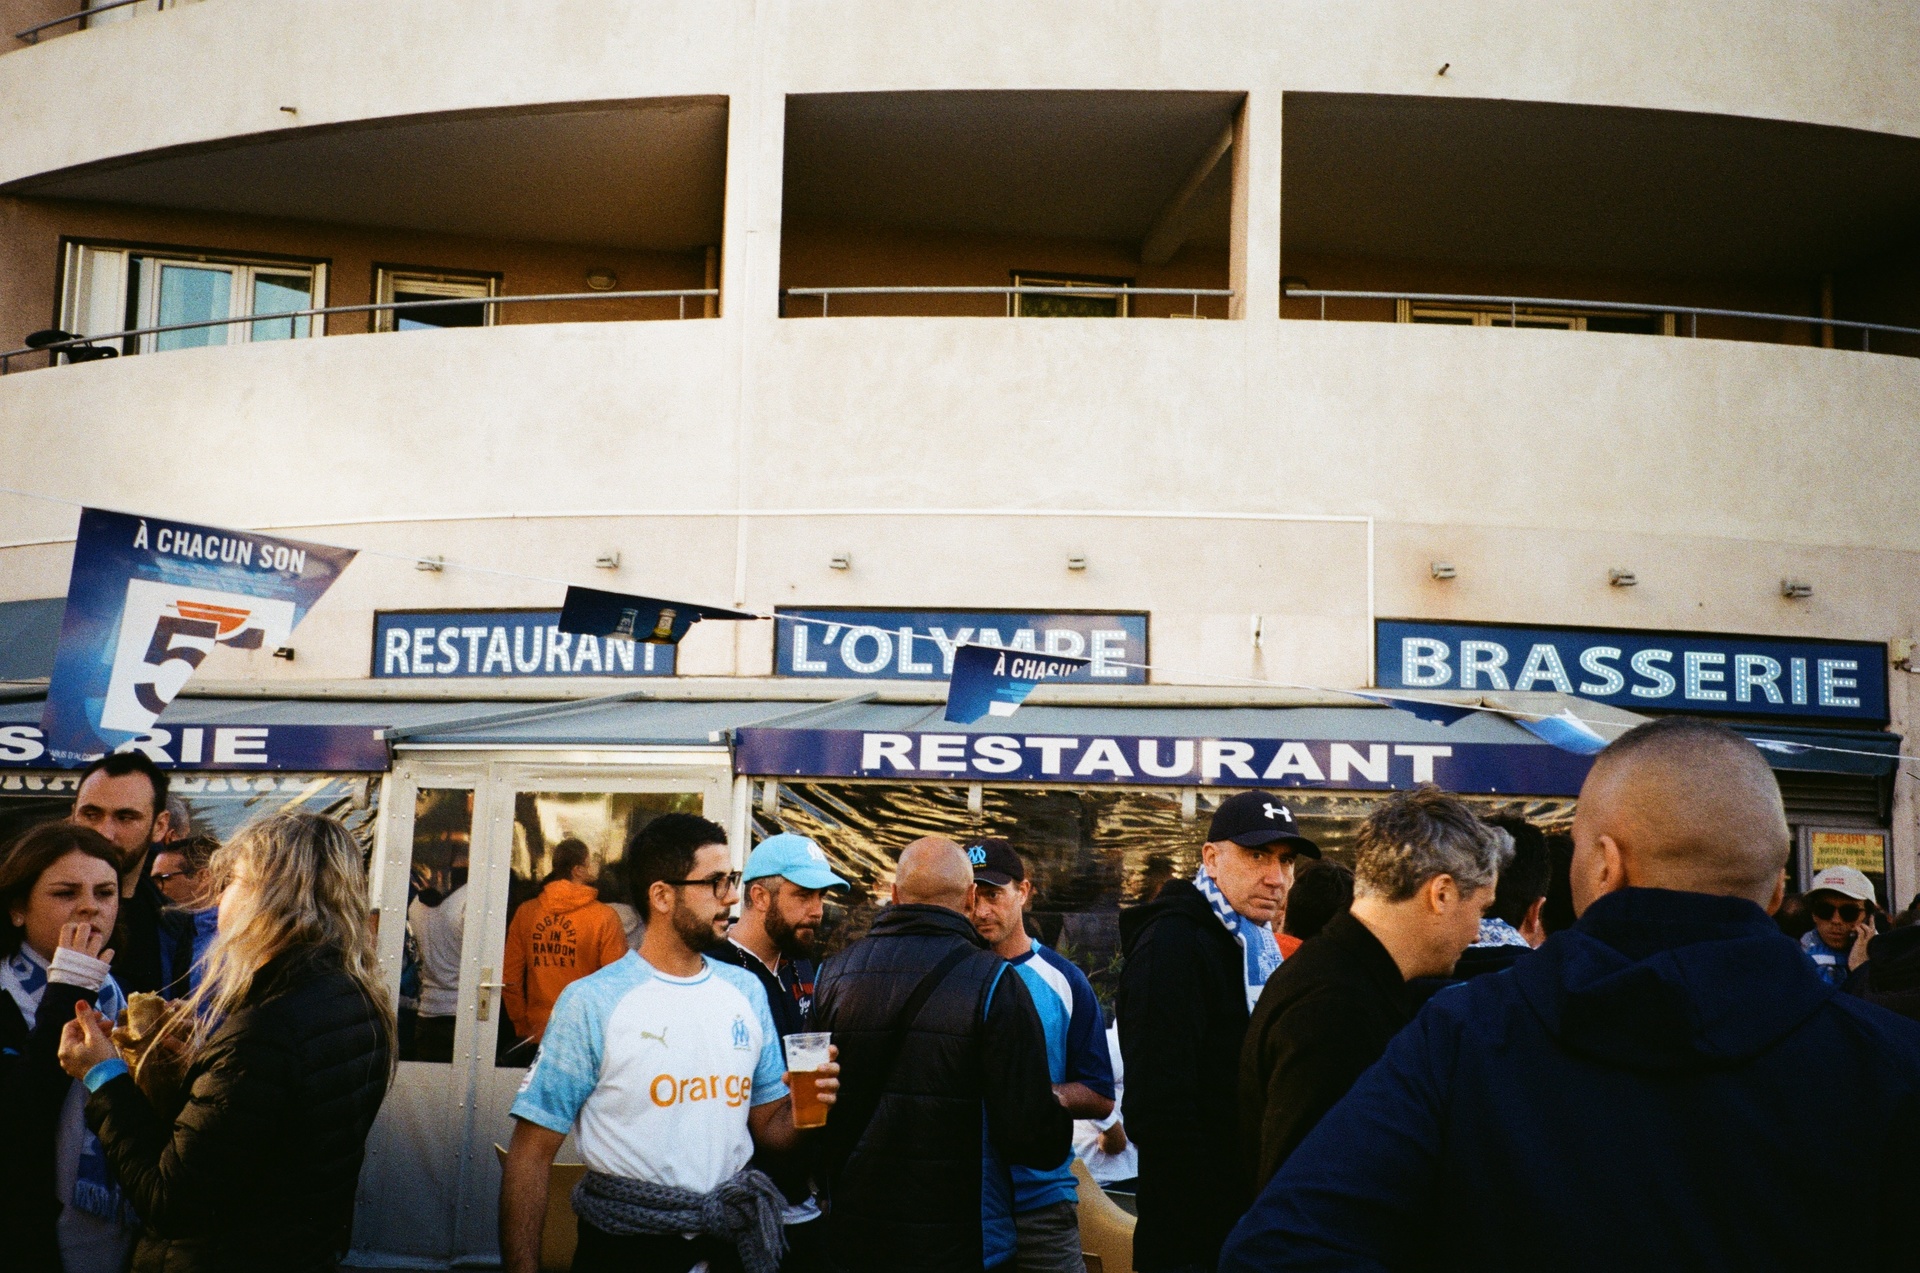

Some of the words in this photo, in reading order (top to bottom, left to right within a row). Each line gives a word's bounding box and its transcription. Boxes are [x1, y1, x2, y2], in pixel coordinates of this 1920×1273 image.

[134, 520, 149, 550] À
[157, 528, 254, 566] CHACUN
[258, 546, 306, 574] SON
[993, 652, 1005, 676] À
[1401, 636, 1861, 708] BRASSERIE
[0, 725, 269, 763] SRIE
[861, 732, 1452, 783] RESTAURANT
[532, 912, 577, 945] DOGFIGHT
[550, 930, 562, 942] IN
[532, 942, 576, 957] RANDOM
[533, 956, 576, 968] ALLEY
